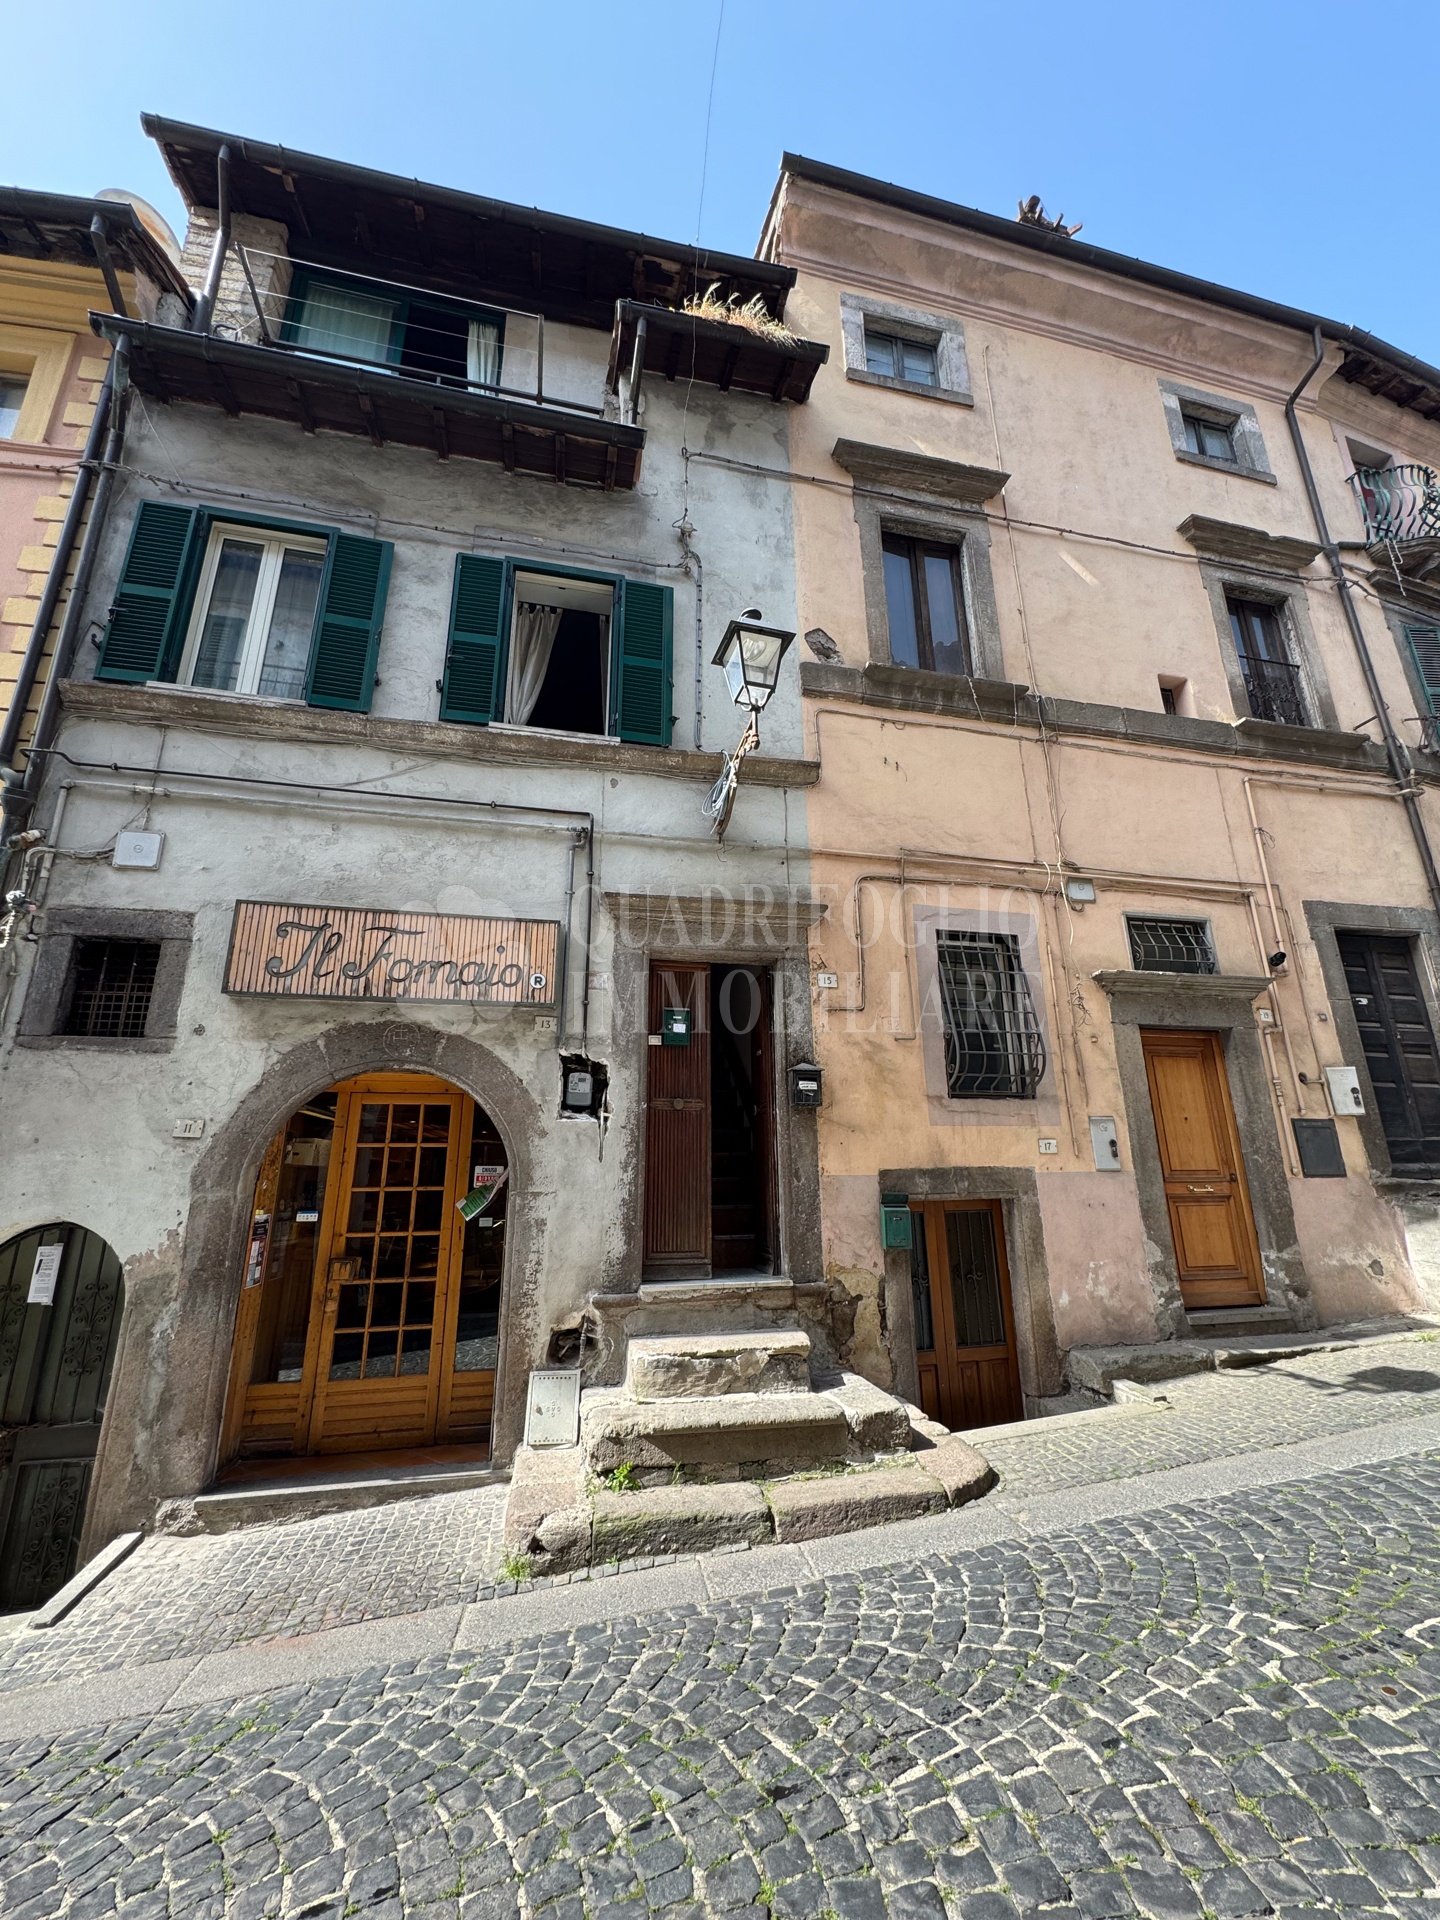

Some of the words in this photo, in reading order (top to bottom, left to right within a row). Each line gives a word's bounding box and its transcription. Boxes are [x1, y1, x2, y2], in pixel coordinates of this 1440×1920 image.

[266, 921, 343, 979] Il
[343, 926, 524, 988] Fornaio
[823, 976, 832, 985] 15
[541, 1020, 551, 1029] 13
[183, 1123, 192, 1133] 11
[1044, 1142, 1052, 1151] 17
